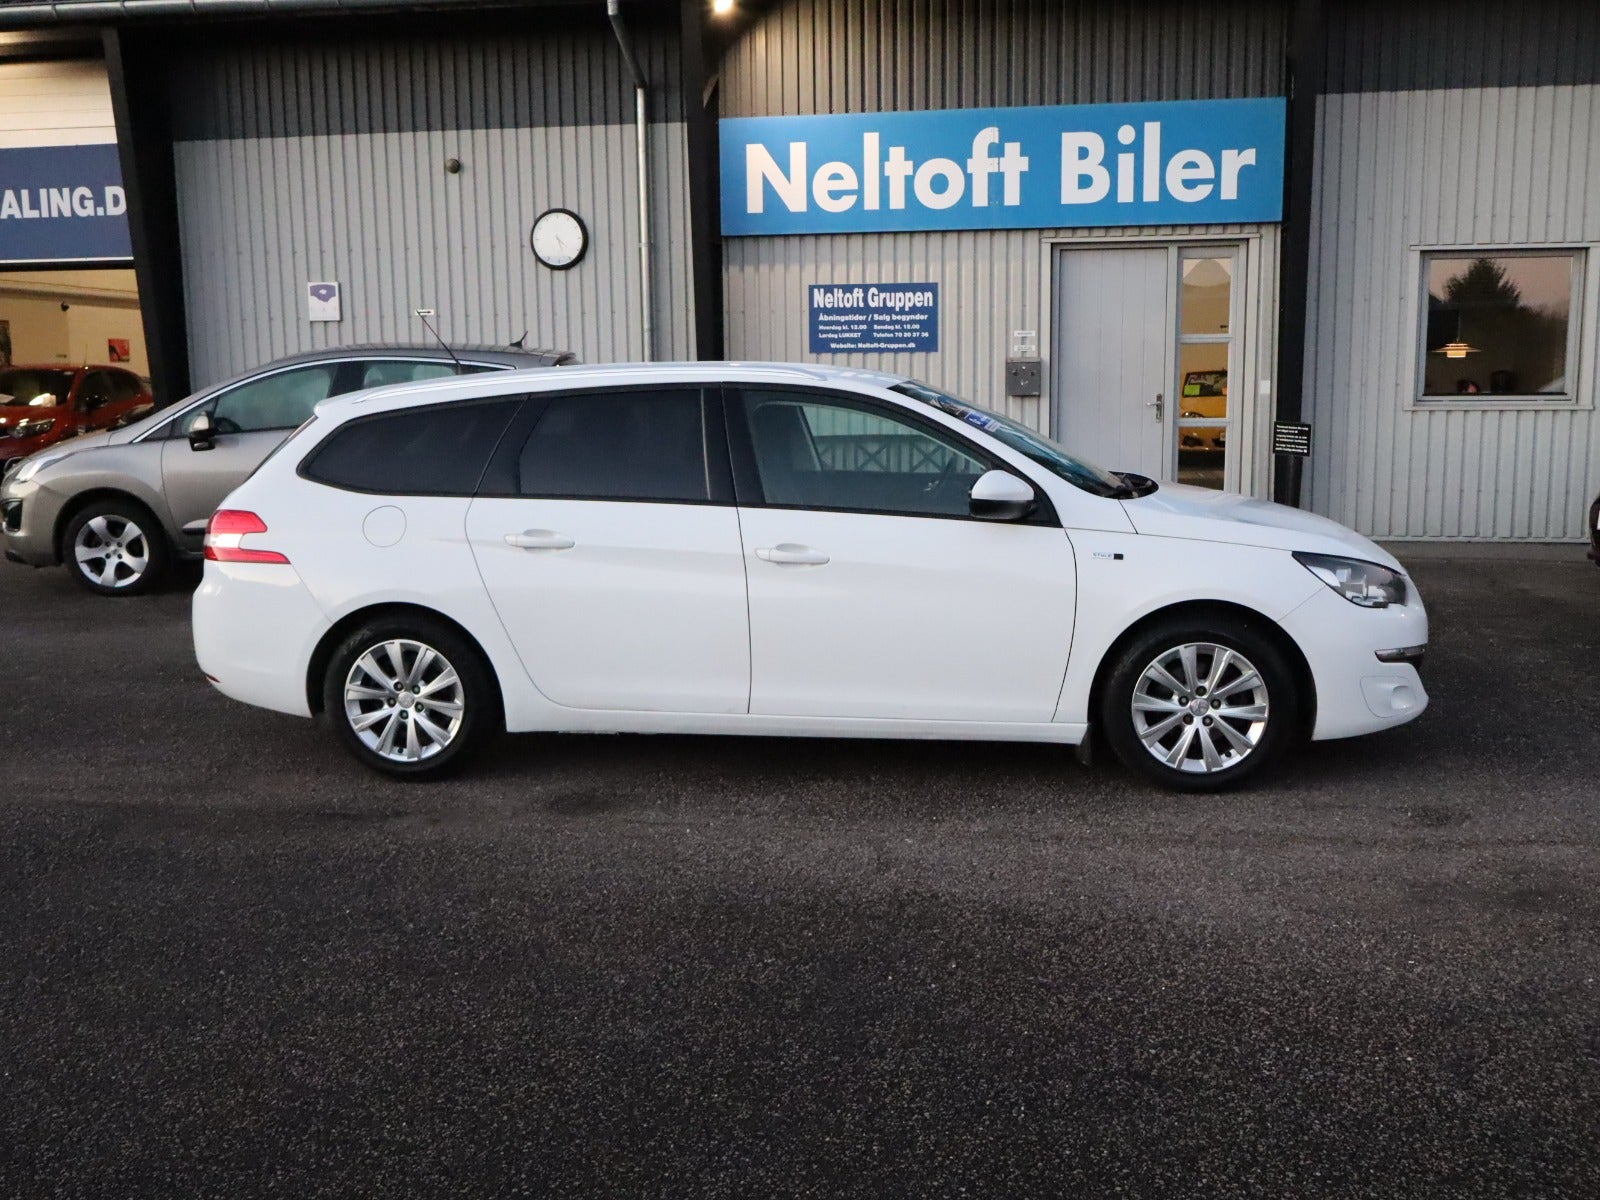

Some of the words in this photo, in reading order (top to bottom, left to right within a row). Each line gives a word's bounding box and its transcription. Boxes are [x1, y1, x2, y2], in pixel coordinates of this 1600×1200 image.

[746, 126, 1028, 214] Neltoft
[1061, 121, 1256, 205] Biler
[0, 186, 127, 219] ALING.D
[813, 287, 864, 308] Neltoft
[867, 287, 933, 312] Gruppen
[818, 313, 867, 322] Åbningstider
[891, 313, 928, 322] begynder
